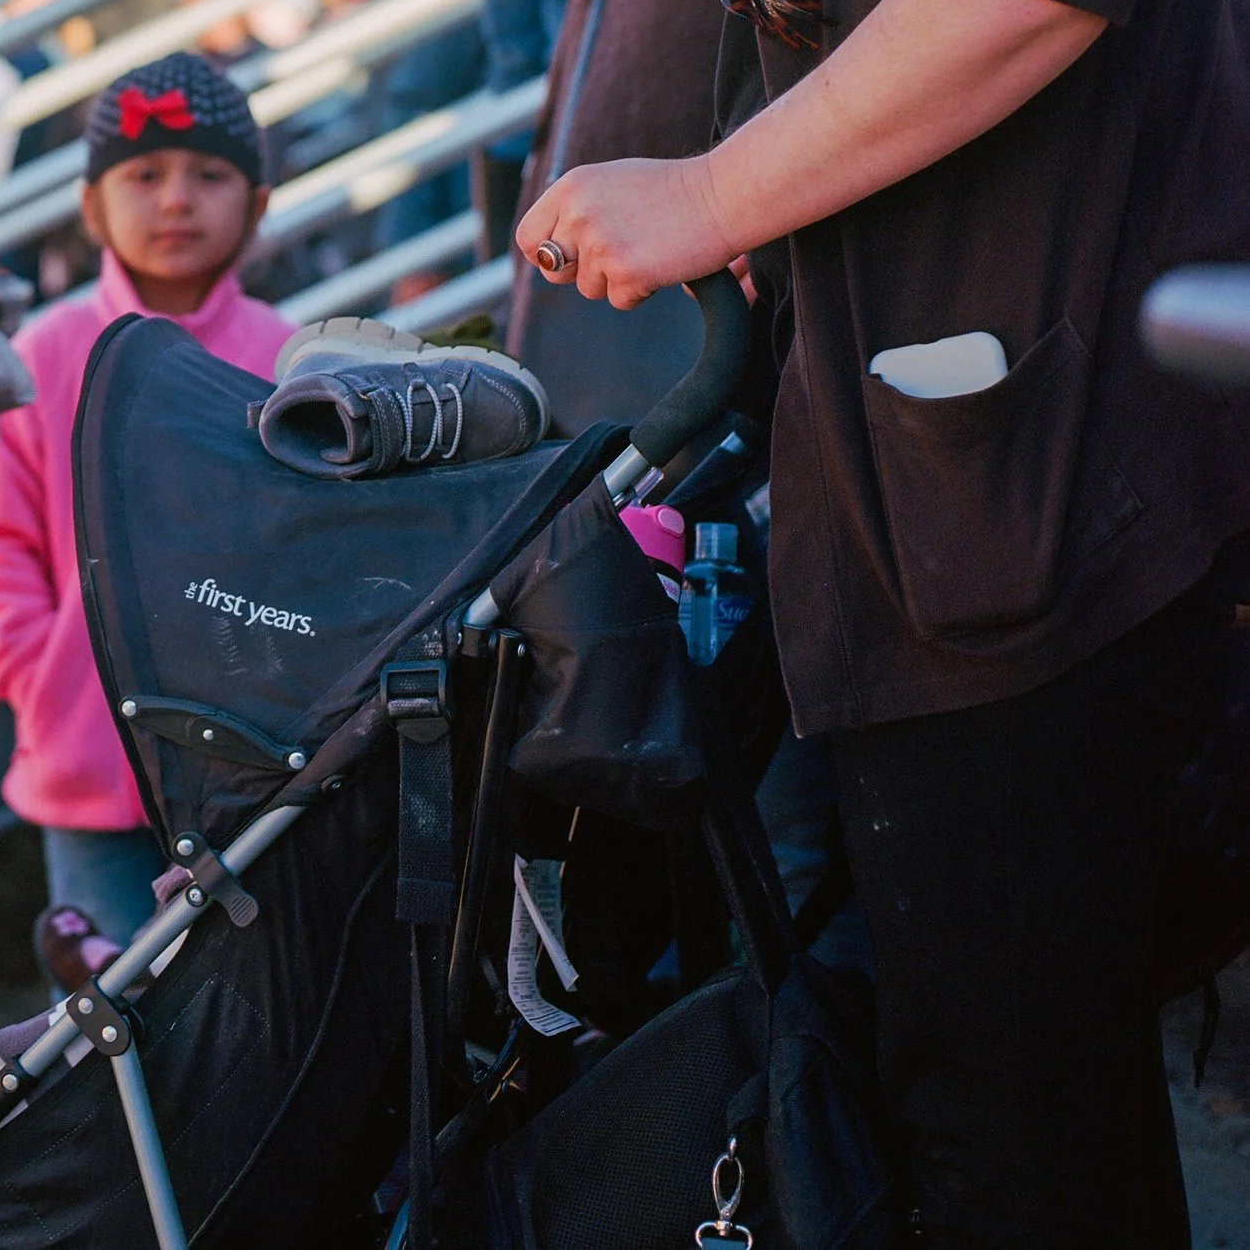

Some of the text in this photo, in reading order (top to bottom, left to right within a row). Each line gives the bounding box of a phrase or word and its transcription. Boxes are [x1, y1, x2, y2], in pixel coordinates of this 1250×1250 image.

[184, 578, 316, 637] the first years.
